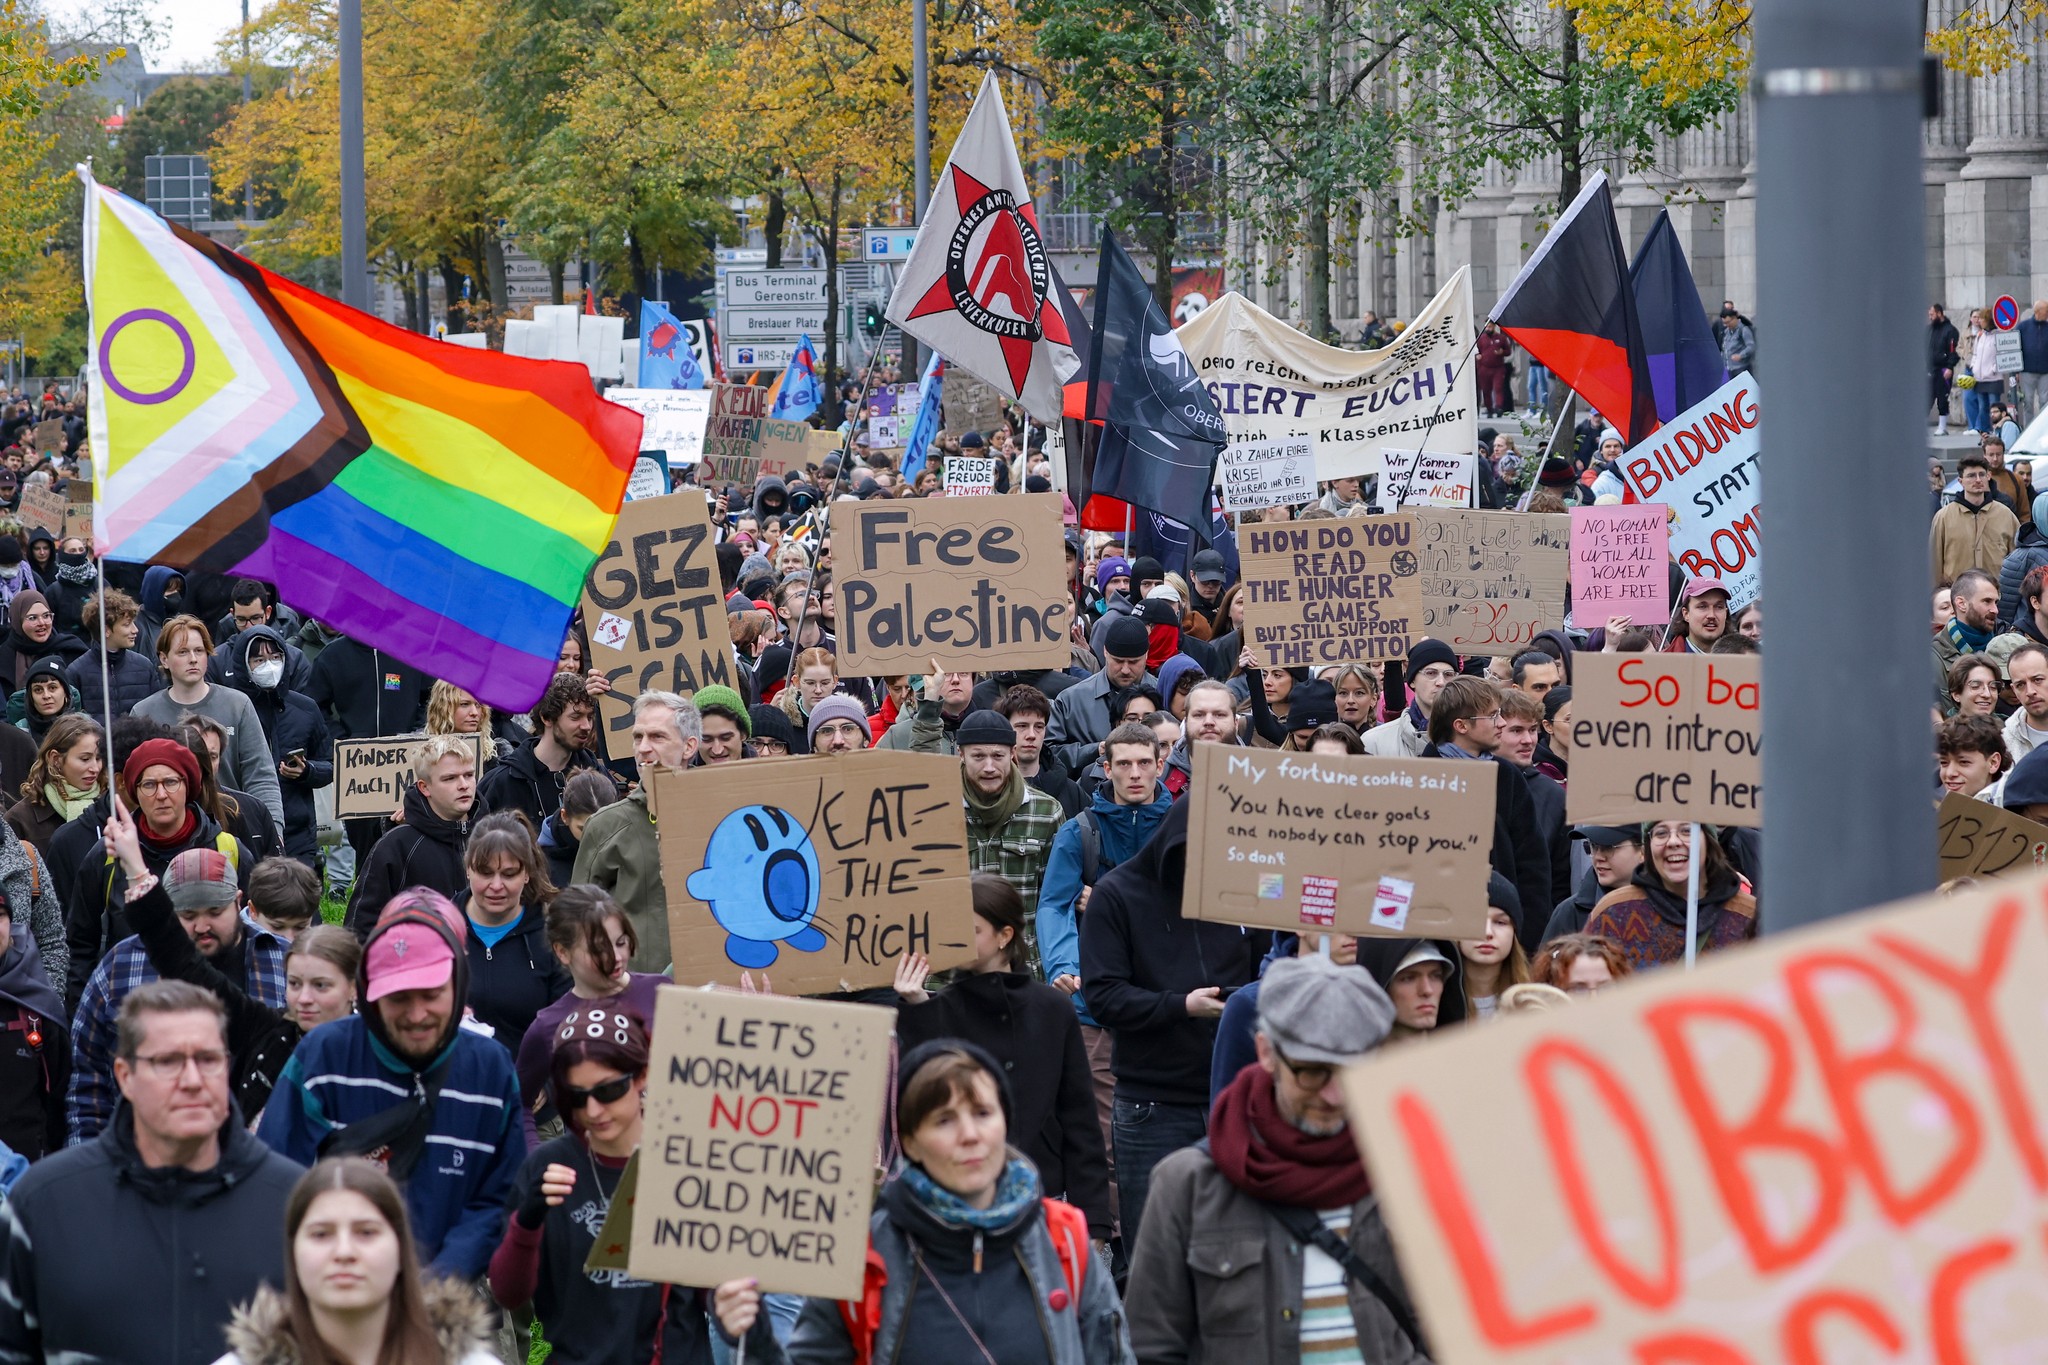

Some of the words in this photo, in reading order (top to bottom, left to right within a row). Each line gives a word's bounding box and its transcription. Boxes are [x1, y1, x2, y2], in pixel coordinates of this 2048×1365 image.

[951, 203, 985, 259] OFFENES
[735, 275, 758, 287] Bus
[763, 275, 817, 286] Terminal
[755, 291, 818, 301] Gereonstr.
[748, 317, 792, 329] Breslauer
[796, 317, 818, 328] Platz
[954, 289, 1027, 336] LEVERKUSEN
[757, 351, 794, 361] HRS-Ze
[1322, 373, 1378, 389] nicht
[715, 384, 768, 418] KEINE
[1206, 381, 1316, 418] SIERT
[705, 416, 762, 443] WAFFEN
[1320, 408, 1466, 443] Klassenzimmer
[703, 438, 751, 456] BESSERE
[1222, 450, 1243, 465] WIR
[1248, 447, 1283, 461] ZAHLEN
[1286, 445, 1309, 456] EURE
[1626, 389, 1761, 499] BILDUNG
[703, 456, 760, 485] SCHULEN
[949, 460, 992, 472] FRIEDE
[1385, 454, 1409, 467] Wir
[1389, 471, 1411, 480] uns
[1420, 470, 1453, 480] euer
[948, 472, 991, 484] FREUDE
[1225, 468, 1259, 484] KRISE
[1270, 480, 1282, 488] IHR
[1286, 476, 1301, 486] DIE
[1229, 495, 1270, 506] RECHNUNG
[1275, 492, 1312, 504] ZERREIST
[1250, 529, 1309, 554] HOW
[1318, 525, 1359, 550] DO
[1363, 521, 1411, 547] YOU
[1529, 519, 1571, 550] them
[1580, 518, 1606, 535] NO
[1610, 516, 1662, 533] WOMAN
[1595, 534, 1609, 546] IS
[1615, 533, 1651, 545] FREE
[860, 511, 1021, 571] Free
[1580, 549, 1624, 562] UNTIL
[1627, 546, 1657, 561] ALL
[584, 523, 710, 610] GEZ
[1293, 550, 1366, 577] READ
[1468, 545, 1522, 572] their
[1591, 565, 1650, 579] WOMEN
[1247, 579, 1291, 603] THE
[1298, 573, 1395, 601] HUNGER
[1421, 573, 1479, 600] sters
[1484, 573, 1532, 599] with
[1580, 585, 1614, 600] ARE
[1619, 584, 1658, 599] FREE
[1740, 573, 1759, 589] FÜR
[632, 594, 717, 652] IST
[842, 578, 1066, 655] Palestine
[1302, 600, 1381, 624] GAMES
[1454, 599, 1546, 645] Blood
[1255, 624, 1287, 643] BUT
[1290, 622, 1335, 641] STILL
[1338, 618, 1409, 638] SUPPORT
[1264, 641, 1314, 665] THE
[1618, 658, 1680, 707] So
[1573, 719, 1651, 749] even
[1228, 754, 1266, 784] My
[1277, 757, 1358, 787] fortune
[1362, 770, 1414, 789] cookie
[1419, 773, 1467, 793] said:
[1635, 771, 1692, 804] are
[822, 783, 930, 851] EAT
[1277, 797, 1325, 820] have
[1335, 803, 1379, 821] clear
[1385, 805, 1430, 825] goals
[1227, 824, 1258, 839] and
[1268, 826, 1329, 846] nobody
[1334, 831, 1366, 846] can
[1378, 830, 1419, 855] stop
[1938, 814, 2029, 875] 1312
[1227, 846, 1245, 862] So
[1248, 849, 1287, 866] don't
[838, 857, 922, 898] THE
[716, 1016, 816, 1059] LET'S
[669, 1055, 850, 1100] NORMALIZE
[708, 1092, 819, 1140] NOT
[1393, 899, 2048, 1352] LOBBY
[664, 1134, 842, 1185] ELECTING
[674, 1175, 749, 1214] OLD
[762, 1184, 837, 1225] MEN
[653, 1218, 721, 1252] INTO
[727, 1223, 836, 1265] POWER
